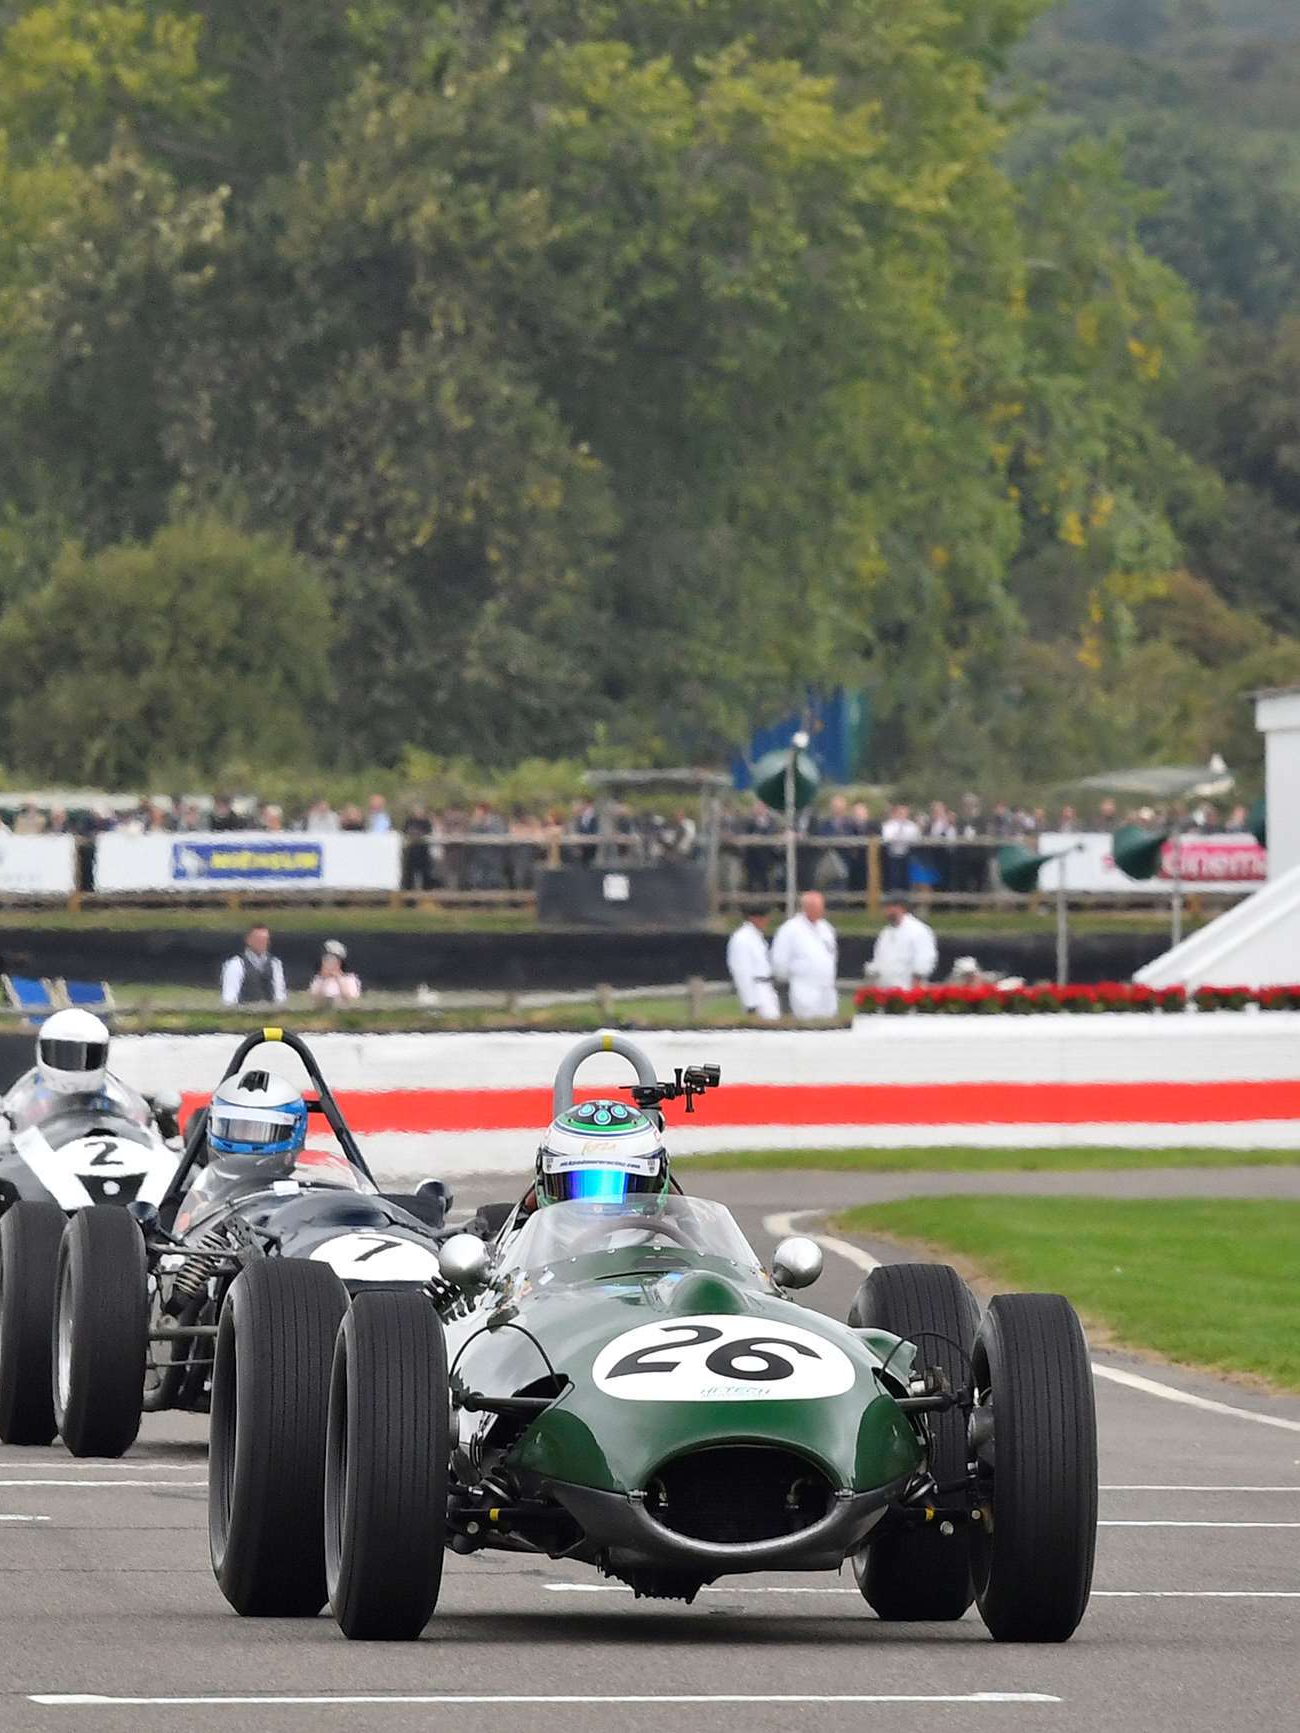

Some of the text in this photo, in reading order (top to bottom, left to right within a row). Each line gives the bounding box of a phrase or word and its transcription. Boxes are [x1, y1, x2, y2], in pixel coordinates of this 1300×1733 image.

[83, 1141, 124, 1166] 2
[354, 1237, 403, 1262] 7
[605, 1325, 822, 1381] 26
